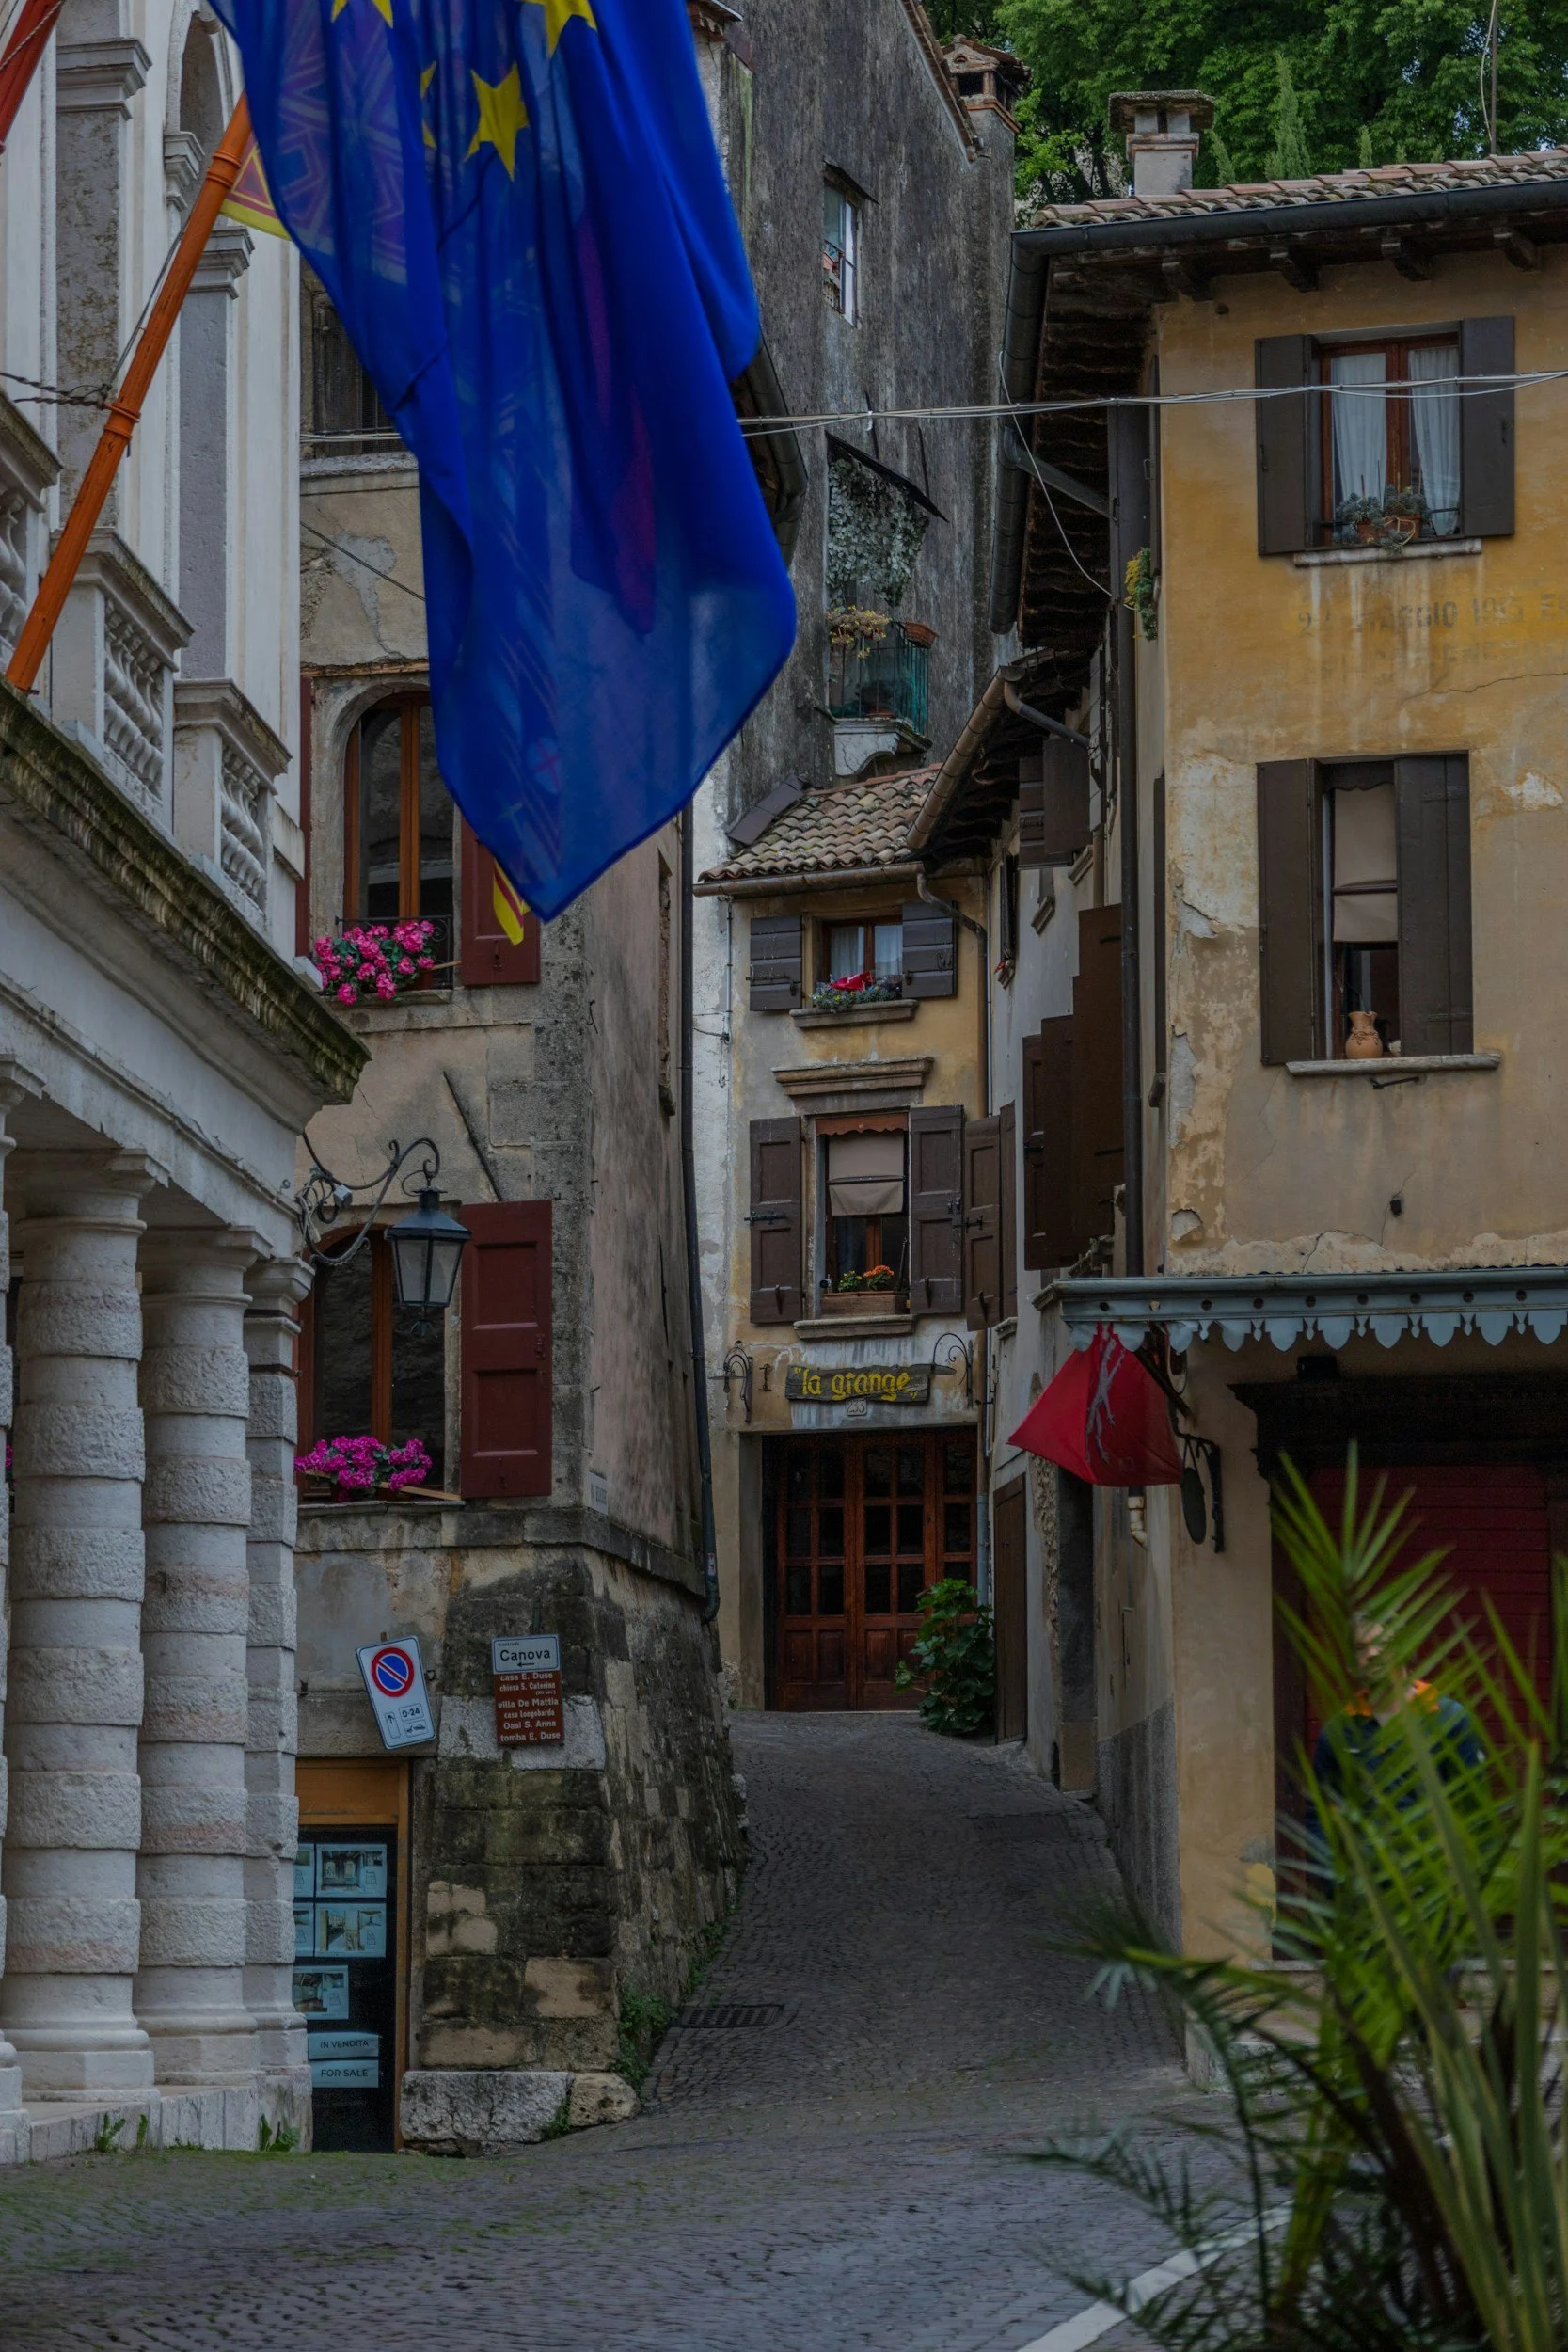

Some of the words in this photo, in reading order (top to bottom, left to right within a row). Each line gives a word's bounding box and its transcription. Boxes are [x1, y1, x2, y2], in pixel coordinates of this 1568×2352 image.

[500, 1649, 551, 1661] Canova
[521, 1672, 530, 1680] E.
[520, 1682, 527, 1691] S.
[529, 1681, 556, 1690] Caterina
[498, 1700, 515, 1708] villa
[518, 1699, 530, 1708] De
[532, 1697, 559, 1707] Mattia
[503, 1722, 522, 1730] Oasi
[535, 1720, 557, 1728] Anna
[500, 1733, 527, 1741] tomba
[529, 1732, 537, 1740] E.
[540, 1731, 561, 1740] Duse
[331, 2040, 370, 2048] VENDITA
[321, 2069, 341, 2077] FOR
[343, 2069, 369, 2077] SALE
